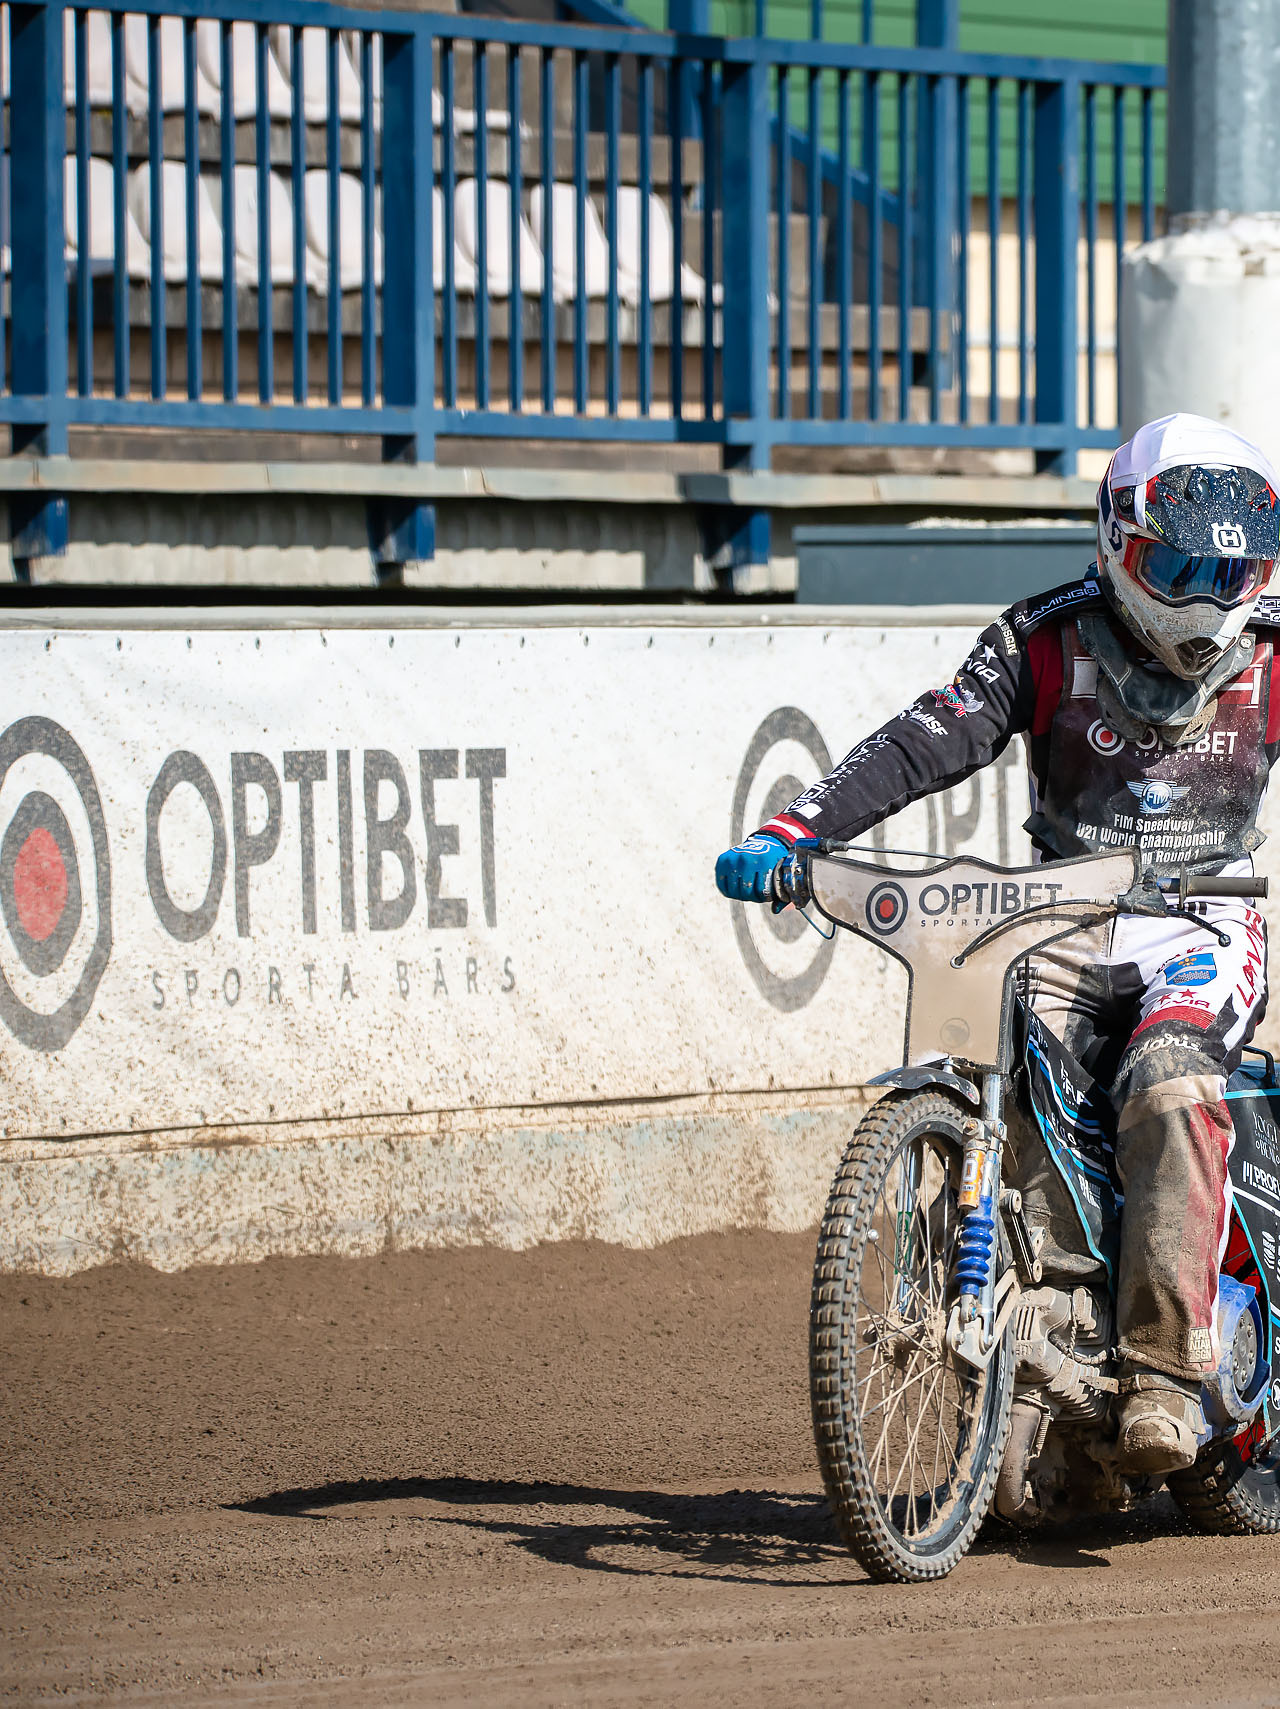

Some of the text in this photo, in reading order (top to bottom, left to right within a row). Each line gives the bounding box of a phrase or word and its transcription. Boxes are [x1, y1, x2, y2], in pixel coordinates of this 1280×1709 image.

[1136, 750, 1190, 761] SPORTA
[1147, 791, 1168, 805] FIM
[1113, 813, 1195, 834] FIM Speedway
[145, 747, 507, 944] OPTIBET
[1076, 822, 1226, 850] U21 World Championship
[1155, 850, 1193, 864] Round
[918, 881, 1064, 916] OPTIBET
[920, 918, 993, 928] SPORTA
[152, 947, 517, 1011] SPORTA BĀRS
